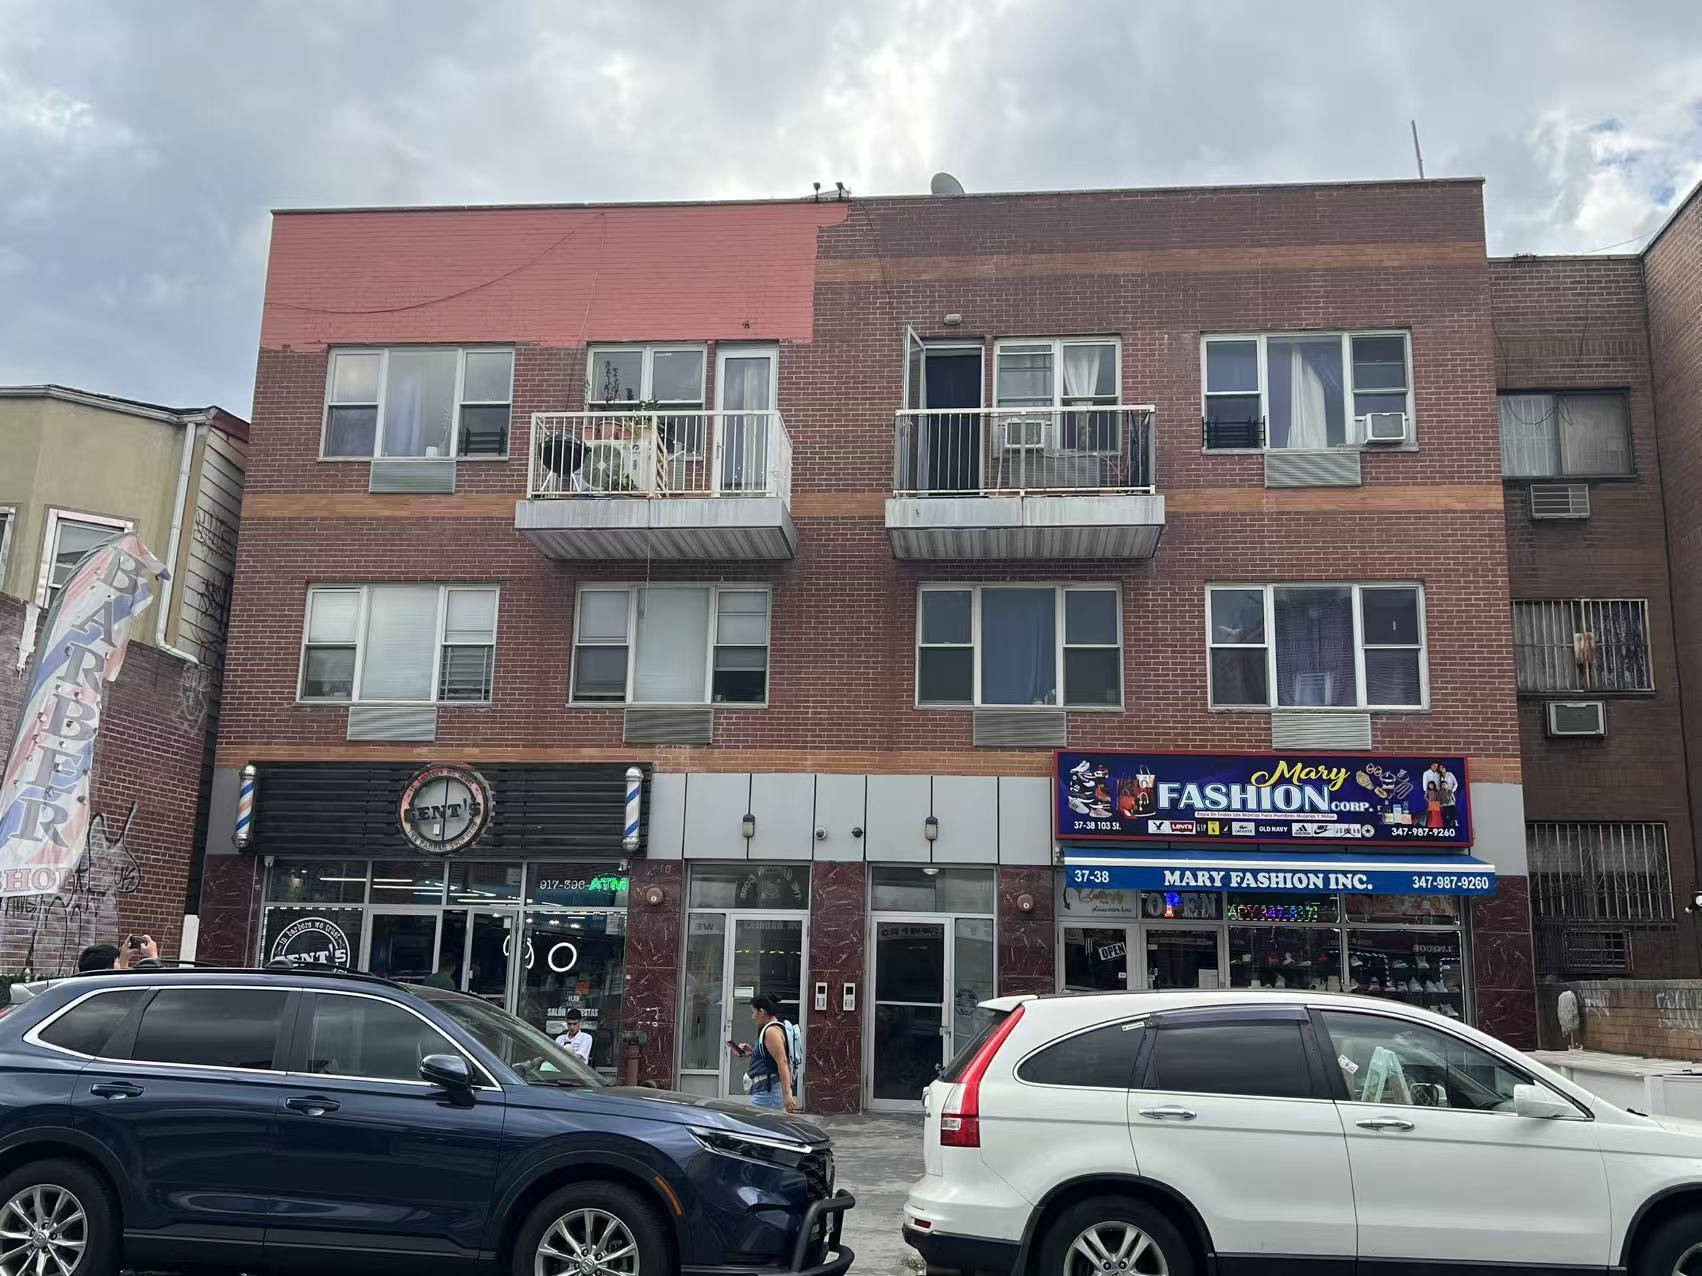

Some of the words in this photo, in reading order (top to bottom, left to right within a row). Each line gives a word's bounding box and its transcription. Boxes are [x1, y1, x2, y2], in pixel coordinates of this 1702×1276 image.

[8, 545, 148, 850] BARBER
[1251, 760, 1350, 791] Mary
[1158, 781, 1330, 811] FASHION
[1331, 801, 1373, 812] CORP.
[1073, 821, 1095, 830] 37-38
[1098, 822, 1111, 830] 103
[1391, 827, 1456, 837] 347-987-9260
[0, 867, 74, 893] HOP
[588, 877, 629, 891] ATM
[1074, 869, 1109, 883] 37-38
[1163, 870, 1225, 887] MARY
[1229, 871, 1324, 889] FASHION
[1329, 873, 1373, 890] INC.
[1412, 875, 1489, 890] 347-987-9260
[1147, 892, 1217, 918] OPEN
[1102, 943, 1125, 959] OPEN
